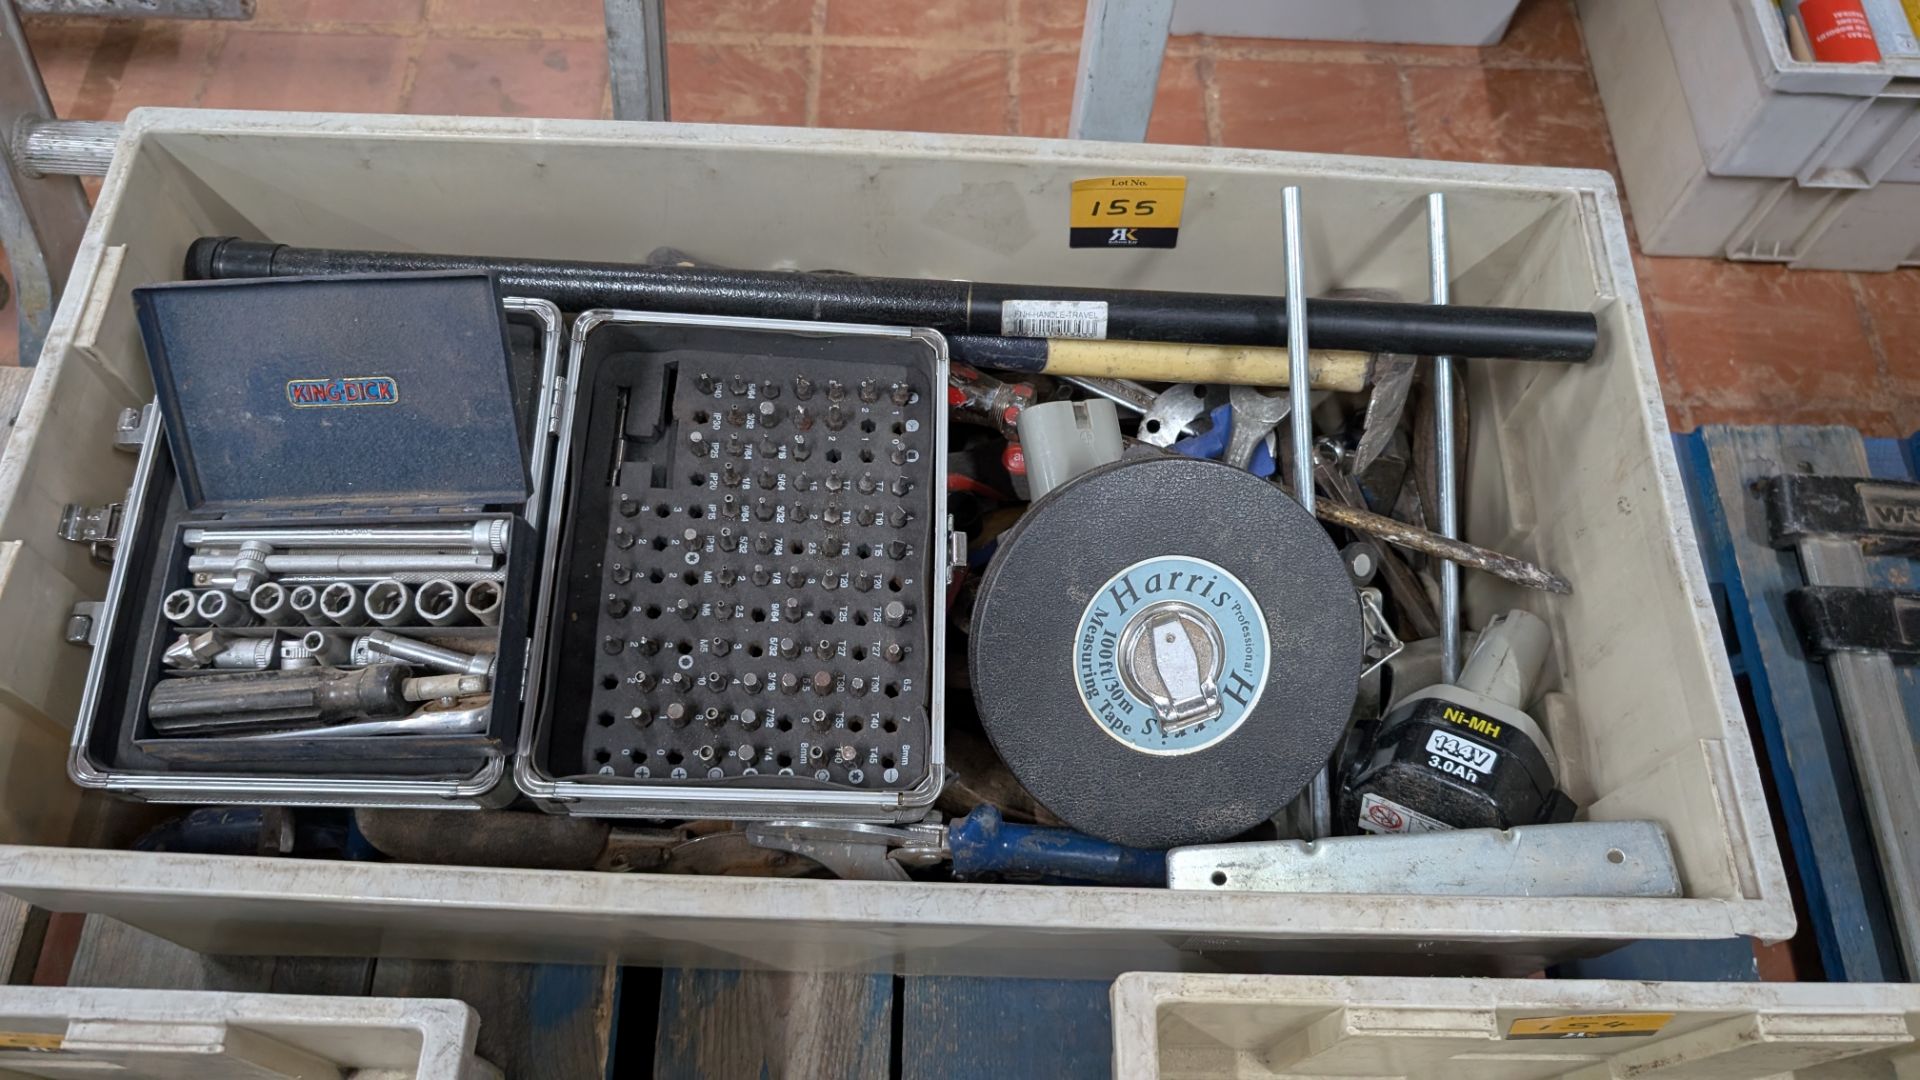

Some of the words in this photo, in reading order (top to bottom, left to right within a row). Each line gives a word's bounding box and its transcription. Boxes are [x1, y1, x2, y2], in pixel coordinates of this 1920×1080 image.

[1091, 199, 1157, 216] 155
[713, 412, 722, 430] IP30
[746, 413, 755, 429] 3/32
[710, 442, 719, 458] IP25
[709, 472, 718, 490] IP20
[742, 478, 751, 490] 1/8
[777, 473, 786, 491] 5/64
[875, 481, 884, 492] T7
[707, 504, 717, 520] IP15
[741, 505, 750, 522] 9/64
[776, 505, 785, 523] 3/32
[842, 510, 851, 524] T10
[875, 512, 884, 526] T10
[739, 536, 748, 554] 5/32
[774, 538, 783, 556] 7/64
[842, 542, 851, 556] T15
[874, 543, 883, 557] T15
[772, 572, 781, 585] 1/8
[840, 573, 849, 589] T20
[873, 574, 882, 590] T20
[1108, 570, 1232, 616] Harris
[770, 603, 779, 622] 9/64
[839, 606, 848, 622] T25
[873, 606, 882, 623] T25
[769, 637, 778, 657] 5/32
[838, 640, 846, 657] T27
[872, 641, 880, 657] T27
[1081, 607, 1109, 701] Measuring
[1097, 699, 1132, 735] Tape
[1098, 628, 1134, 715] 100ft/30m
[697, 677, 706, 686] 10
[837, 675, 845, 692] T30
[871, 675, 880, 693] T30
[765, 708, 775, 728] 7/32
[835, 711, 844, 729] T35
[871, 712, 879, 729] T40
[902, 715, 911, 723] 7
[1443, 707, 1501, 738] Ni-MH
[800, 742, 809, 764] 8mm
[869, 746, 878, 764] T45
[901, 744, 910, 766] 8mm
[1435, 735, 1491, 767] 14.4V
[1428, 755, 1479, 784] 3.0Ah
